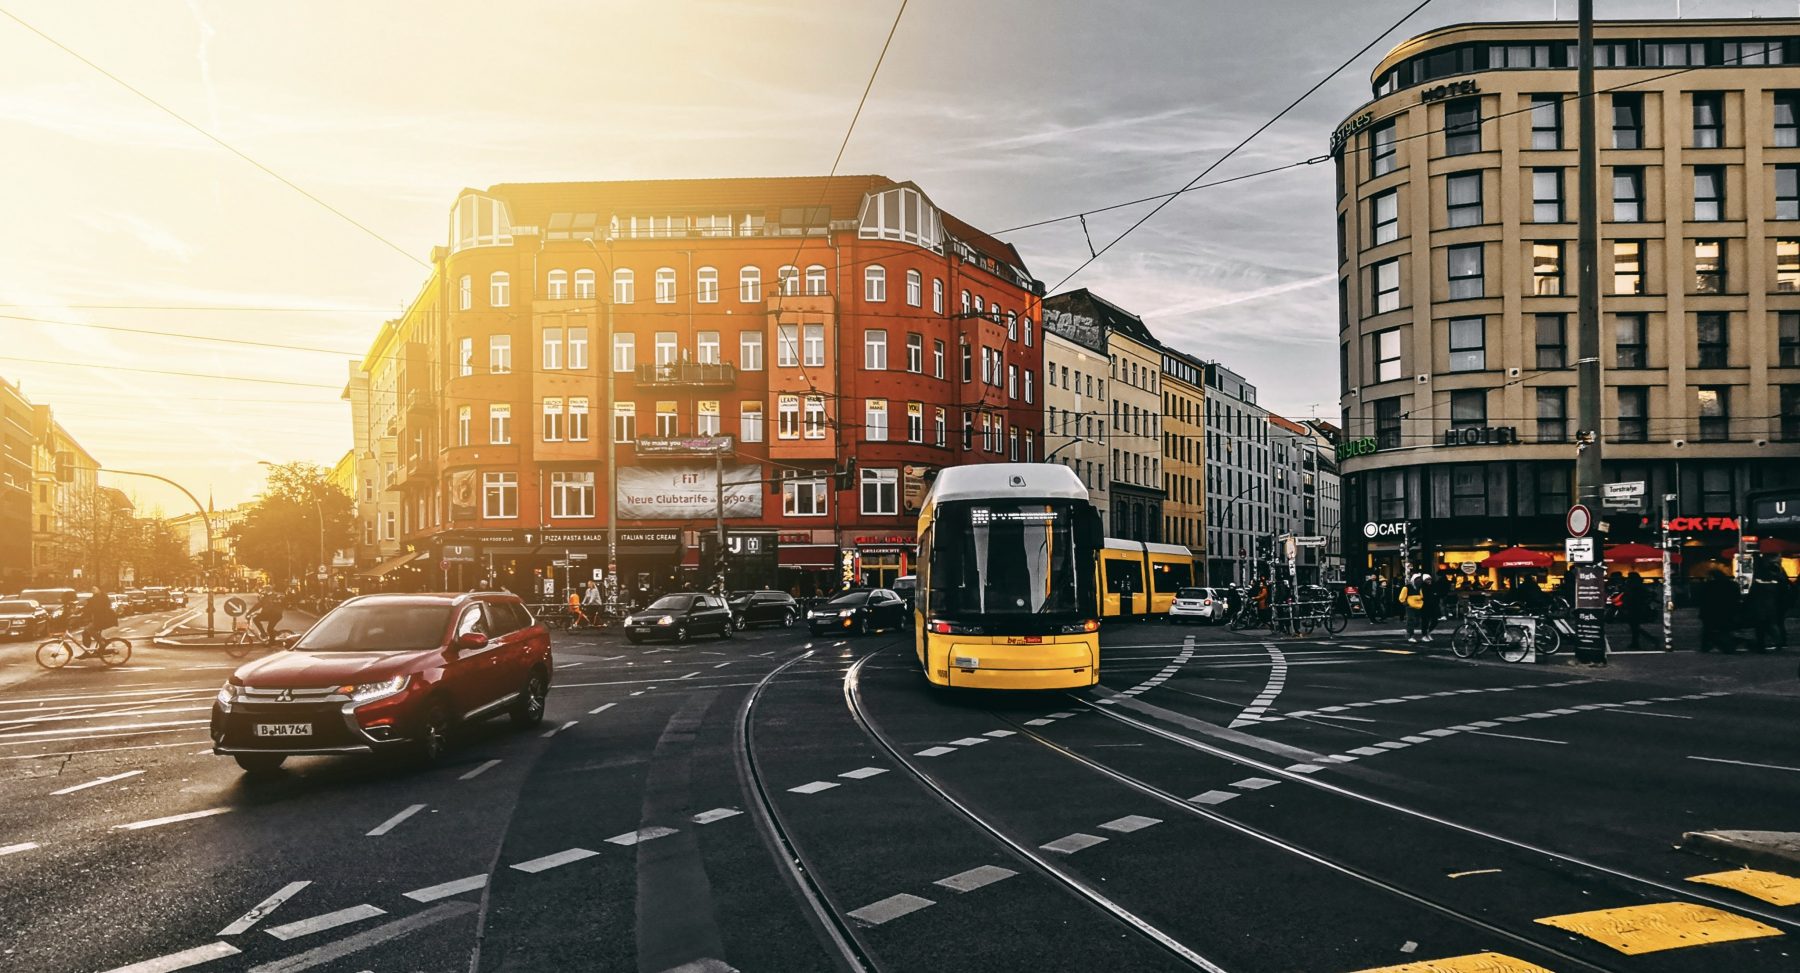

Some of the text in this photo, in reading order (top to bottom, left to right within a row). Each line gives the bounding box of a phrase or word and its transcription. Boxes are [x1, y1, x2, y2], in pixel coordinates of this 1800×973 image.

[1421, 79, 1481, 102] HOTEL
[908, 404, 919, 412] YOU
[1445, 427, 1521, 446] HOTEL
[1609, 484, 1638, 493] Torstraße
[627, 496, 653, 504] Neue
[656, 494, 708, 504] Clubtarife
[1775, 501, 1786, 515] U
[658, 533, 677, 541] CREAM
[455, 546, 462, 555] U
[261, 725, 269, 735] B
[289, 725, 308, 735] 764
